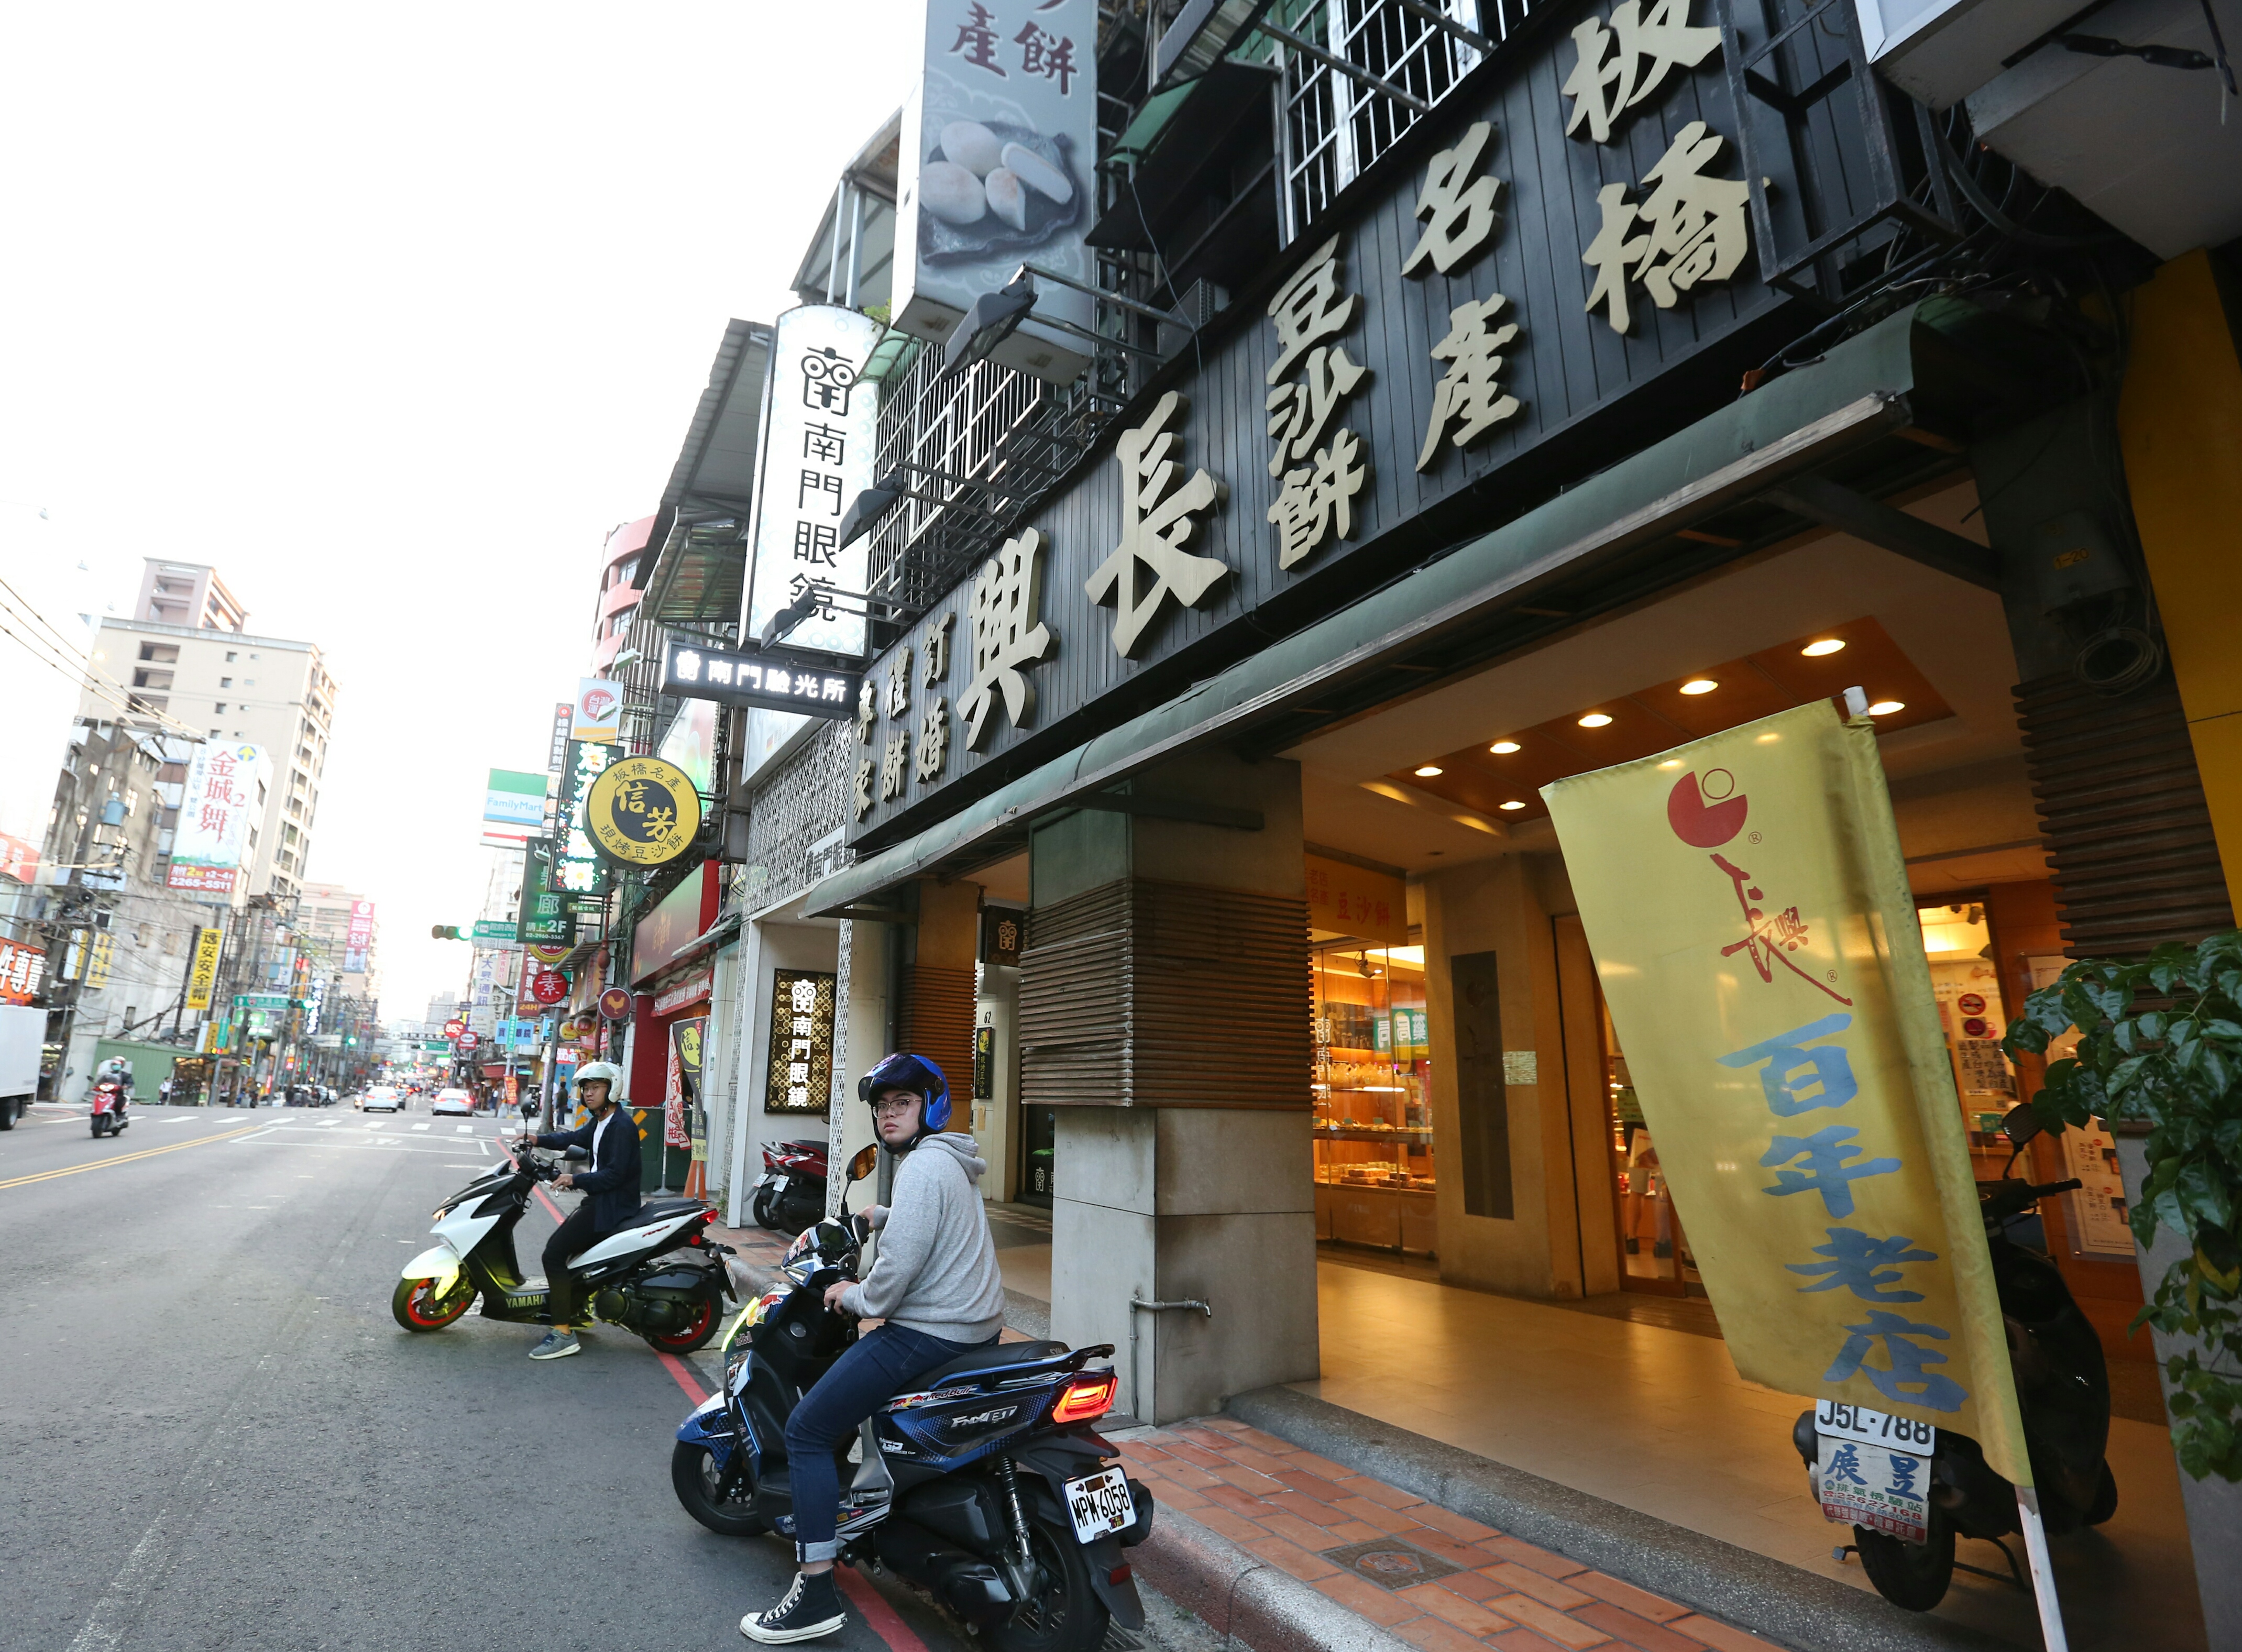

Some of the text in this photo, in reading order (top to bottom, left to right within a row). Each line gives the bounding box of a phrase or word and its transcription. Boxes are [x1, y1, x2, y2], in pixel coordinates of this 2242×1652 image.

[1401, 120, 1520, 472] 名產
[1266, 233, 1368, 571] 豆沙餅
[789, 422, 847, 622] 南門眼鏡
[612, 763, 682, 792] 板橋名產
[196, 751, 237, 844] 金城舞
[487, 797, 543, 812] FamilyMart
[614, 779, 677, 843] 信芳
[600, 824, 684, 860] 現烤豆沙餅
[169, 876, 232, 890] 2265-5511
[1337, 891, 1391, 930] 豆沙餅
[538, 974, 563, 996] 素
[499, 1027, 531, 1038] 寶眼鏡
[984, 1010, 992, 1024] 62
[787, 1015, 812, 1107] 南門眼鏡
[1716, 1013, 1970, 1413] 百年老店
[505, 1294, 546, 1308] YAMAHA
[1071, 1483, 1130, 1529] MPM-6058
